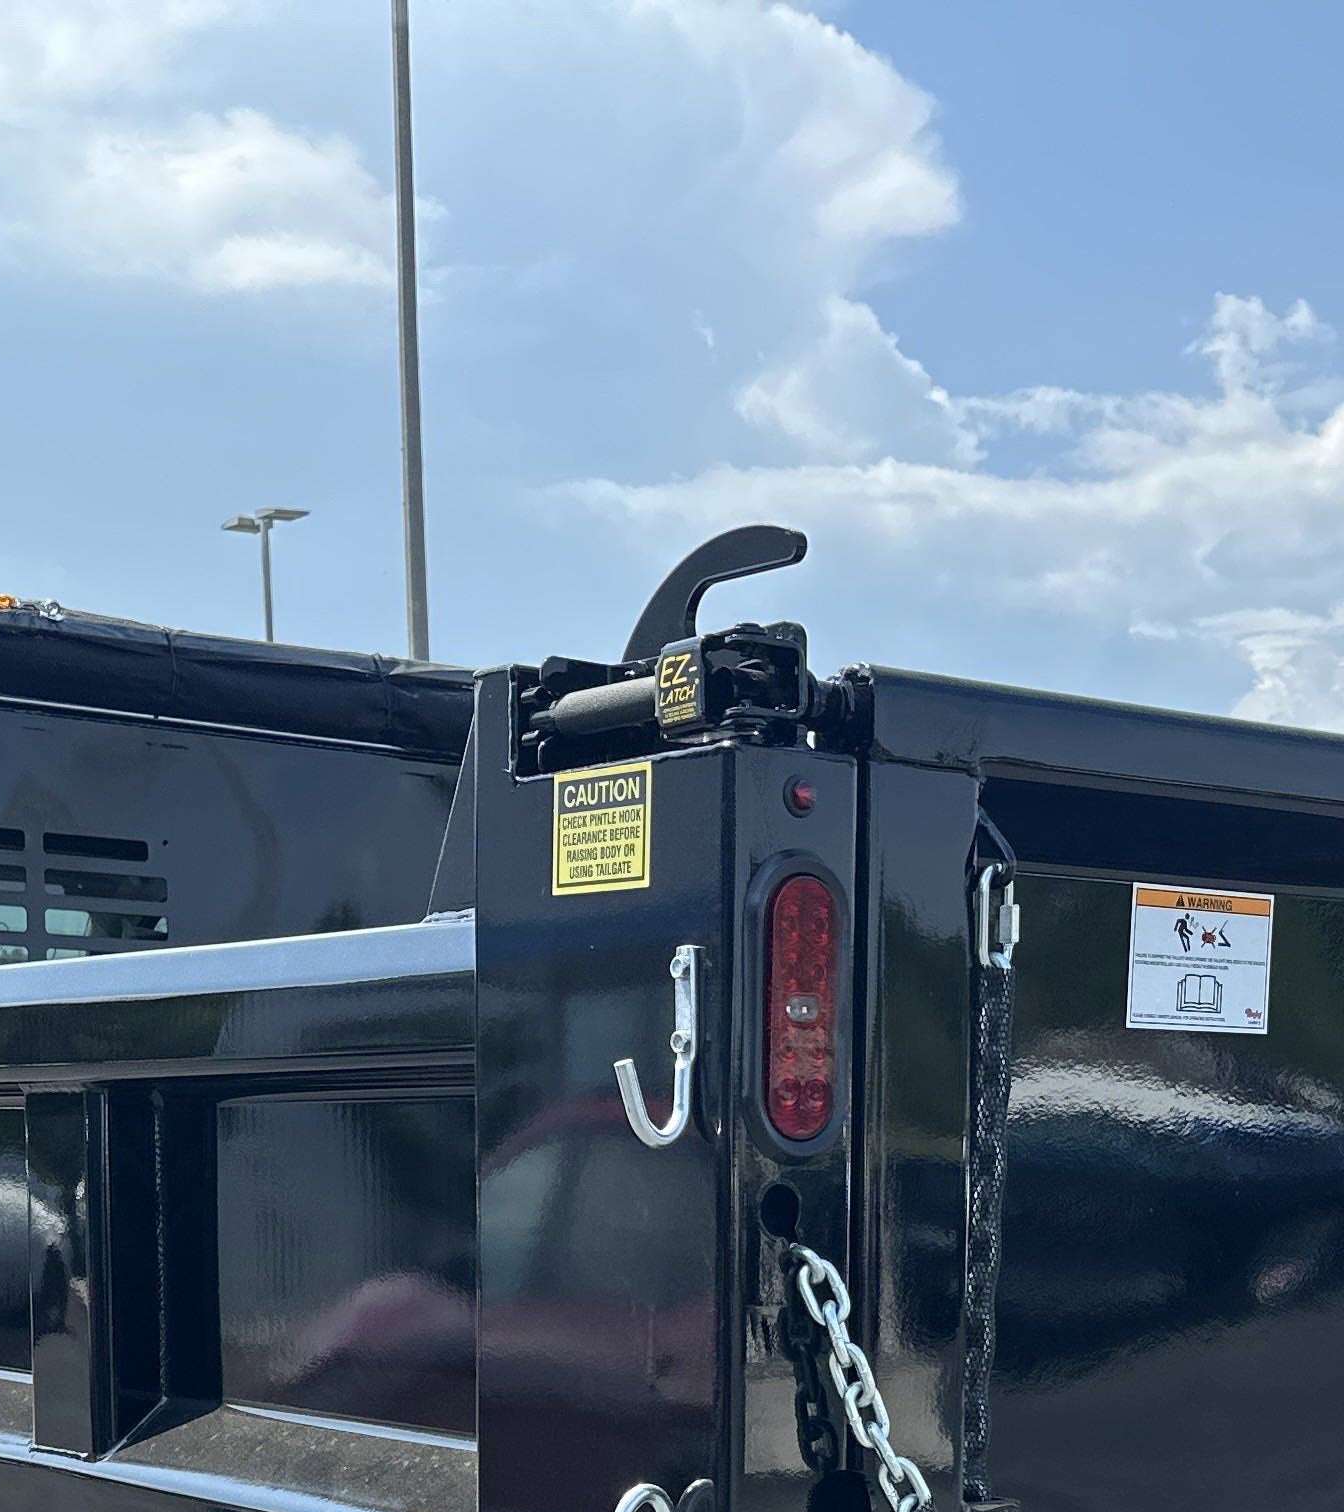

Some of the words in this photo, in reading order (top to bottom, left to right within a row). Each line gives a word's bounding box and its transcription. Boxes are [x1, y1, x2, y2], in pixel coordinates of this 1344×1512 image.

[659, 684, 696, 707] LATCH
[563, 776, 640, 808] CAUTION
[562, 814, 587, 830] CHECK
[590, 811, 617, 826] PINTLE
[619, 808, 642, 823] HOOK
[562, 829, 607, 847] CLEARANCE
[609, 825, 640, 841] BEFORE
[567, 847, 598, 863] RAISING
[600, 845, 621, 860] BODY
[624, 843, 636, 857] OR
[569, 864, 593, 879] USING
[595, 861, 632, 877] TAILGATE
[1187, 896, 1233, 911] WARNING
